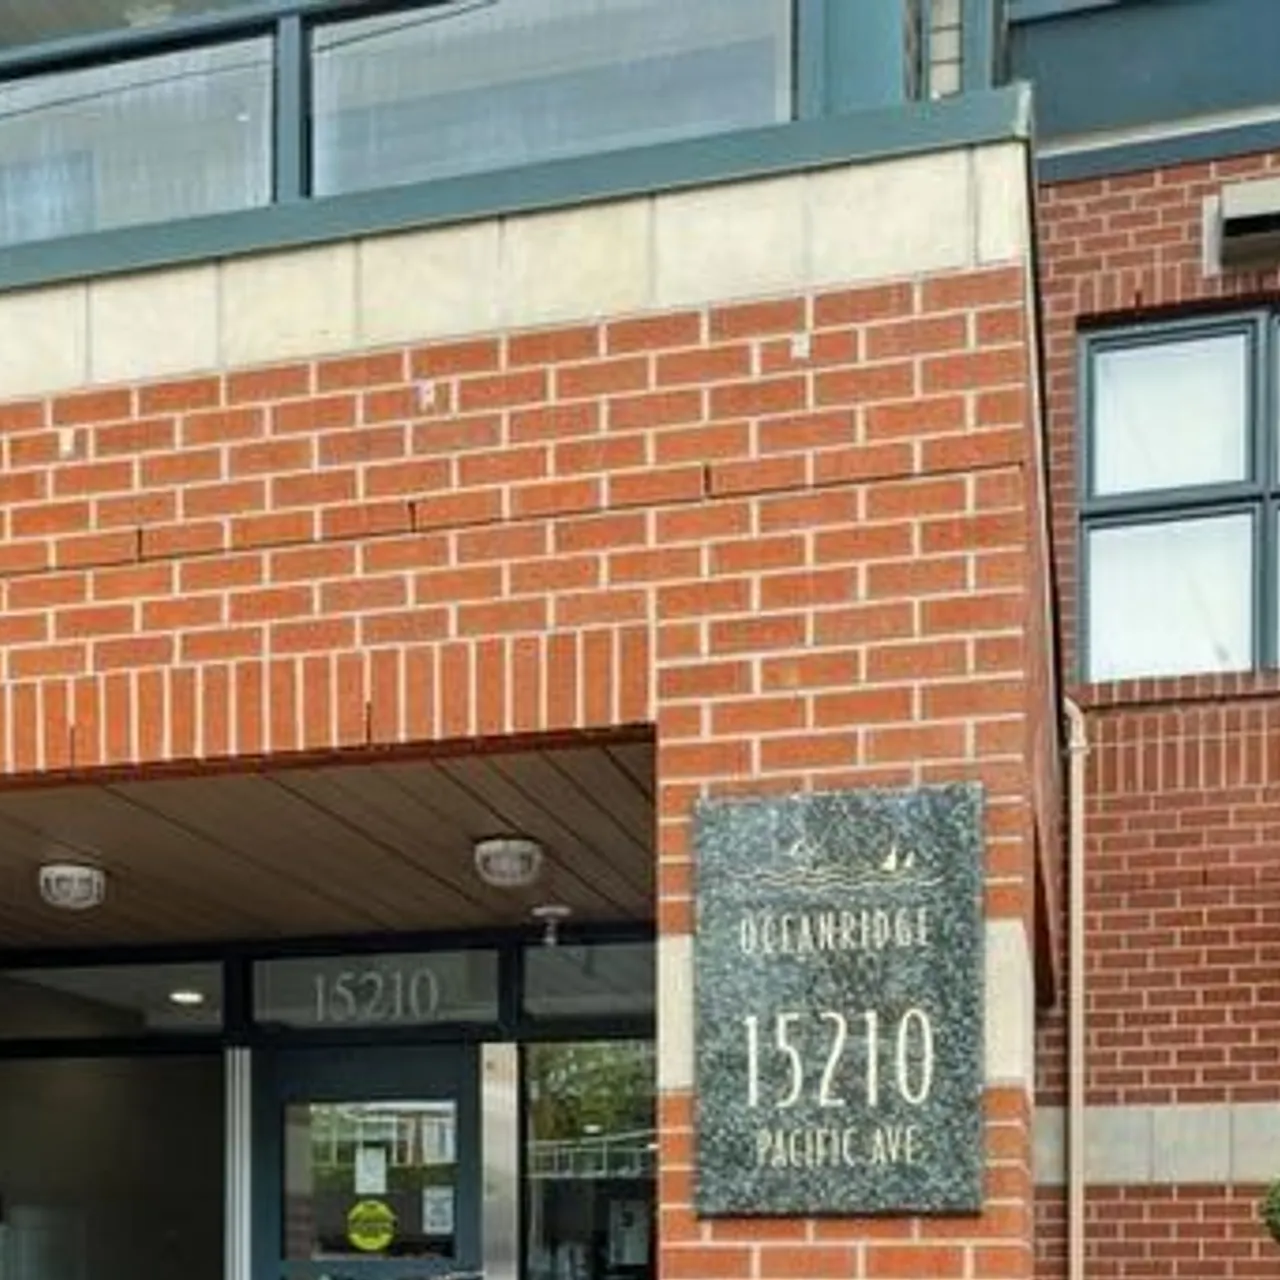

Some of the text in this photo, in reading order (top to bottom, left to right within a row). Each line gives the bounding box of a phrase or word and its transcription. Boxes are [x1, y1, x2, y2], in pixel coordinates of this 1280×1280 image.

[740, 906, 930, 953] OCEANRIDGE
[314, 967, 439, 1022] 15210
[744, 1008, 934, 1108] 15210
[756, 1123, 919, 1169] PACIFIC AVE
